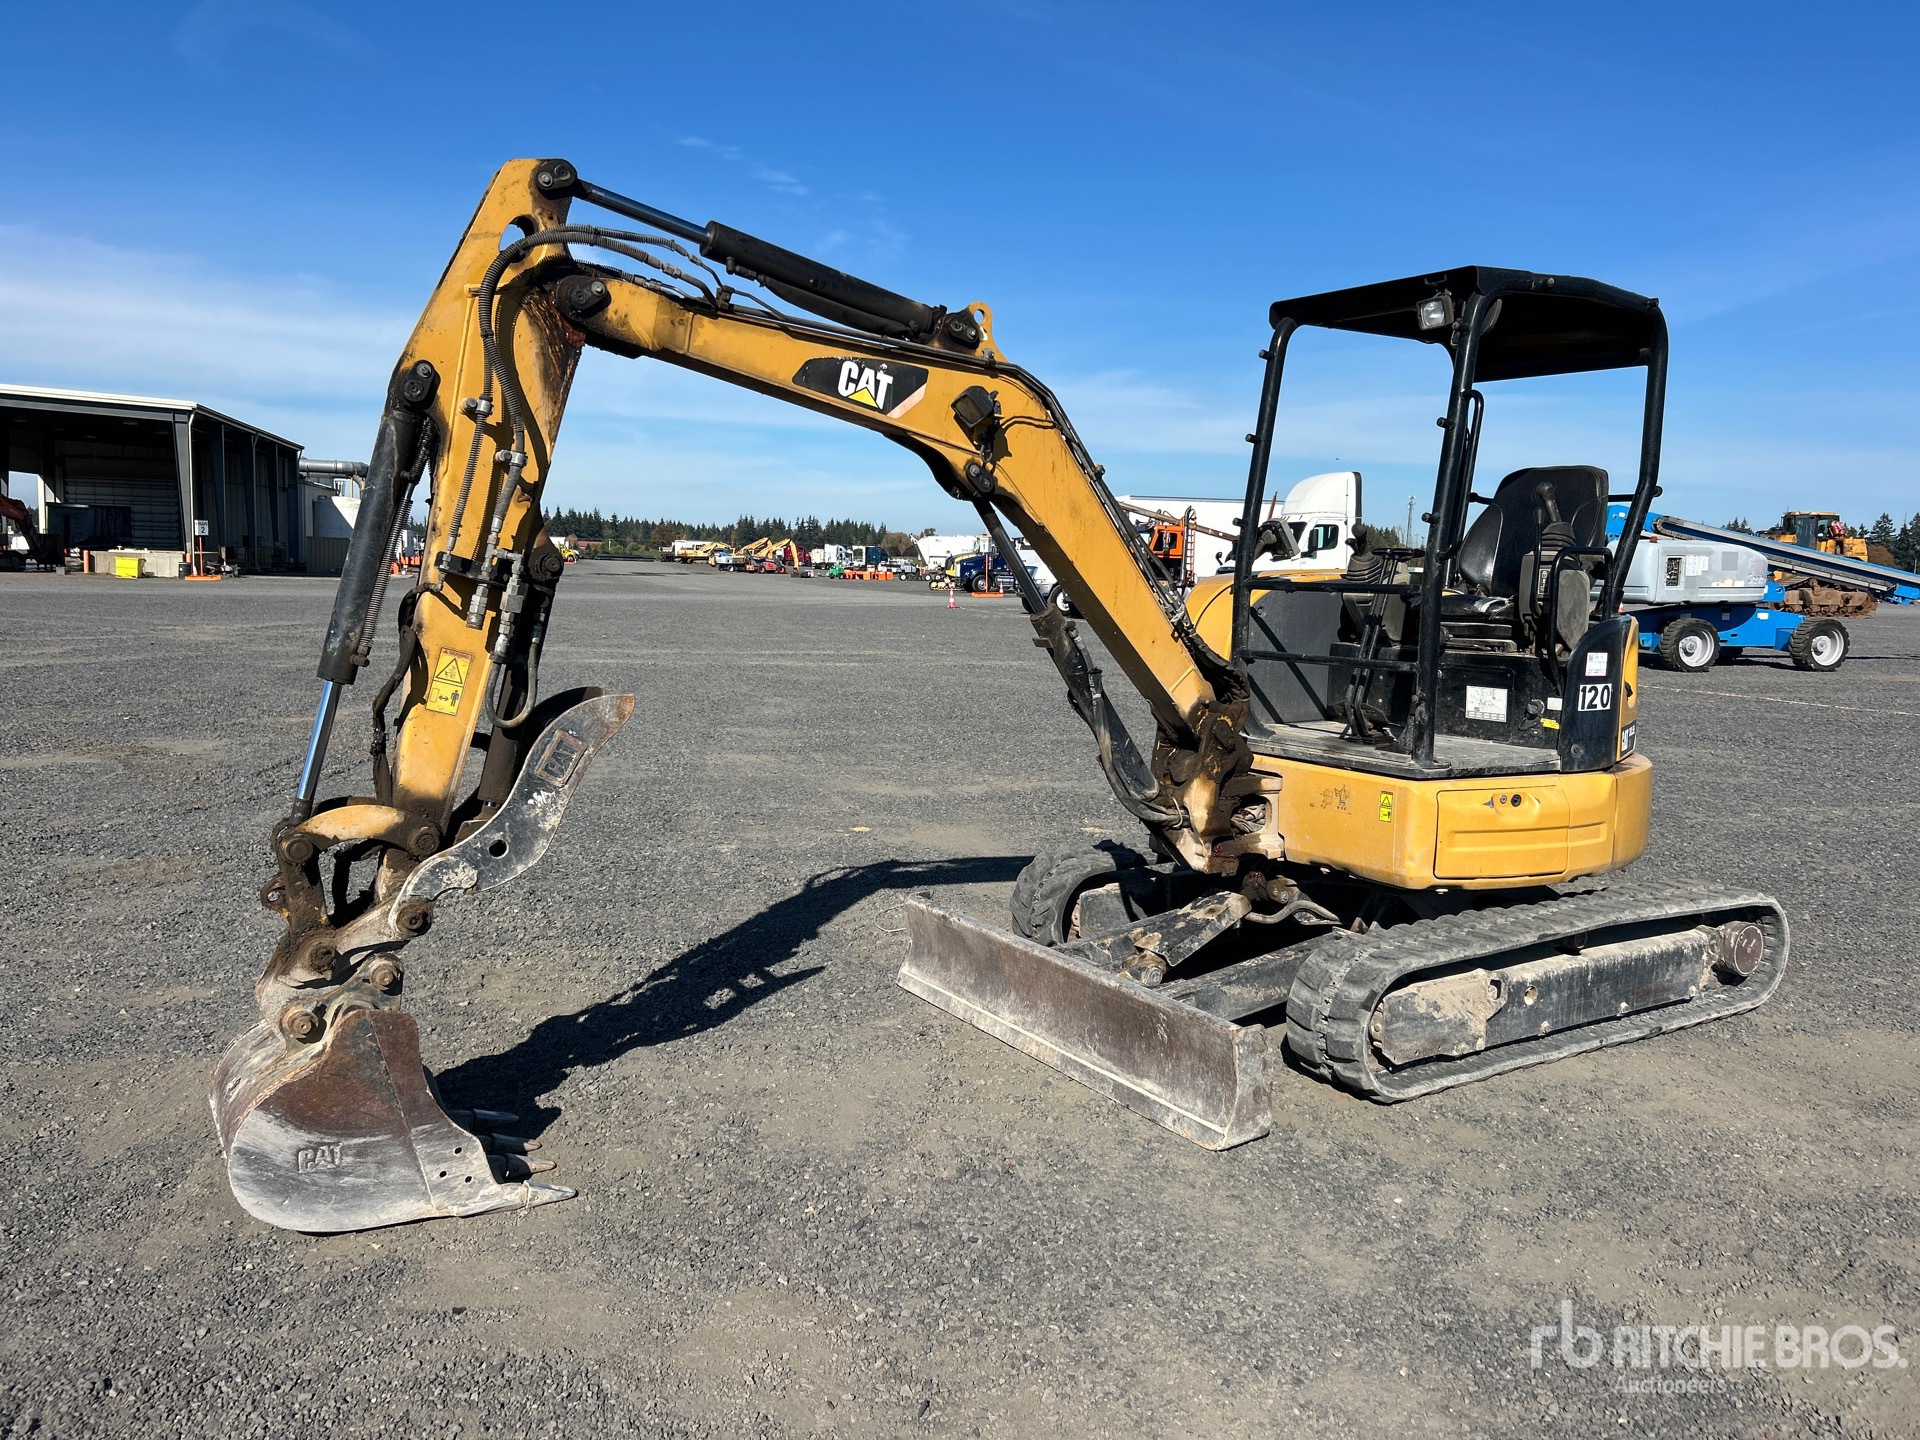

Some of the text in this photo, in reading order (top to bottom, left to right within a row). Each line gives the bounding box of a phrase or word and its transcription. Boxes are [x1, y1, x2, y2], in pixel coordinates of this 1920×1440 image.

[838, 361, 894, 410] CAT
[1580, 685, 1611, 710] 120
[544, 740, 578, 779] CAT
[298, 1143, 343, 1174] CAT
